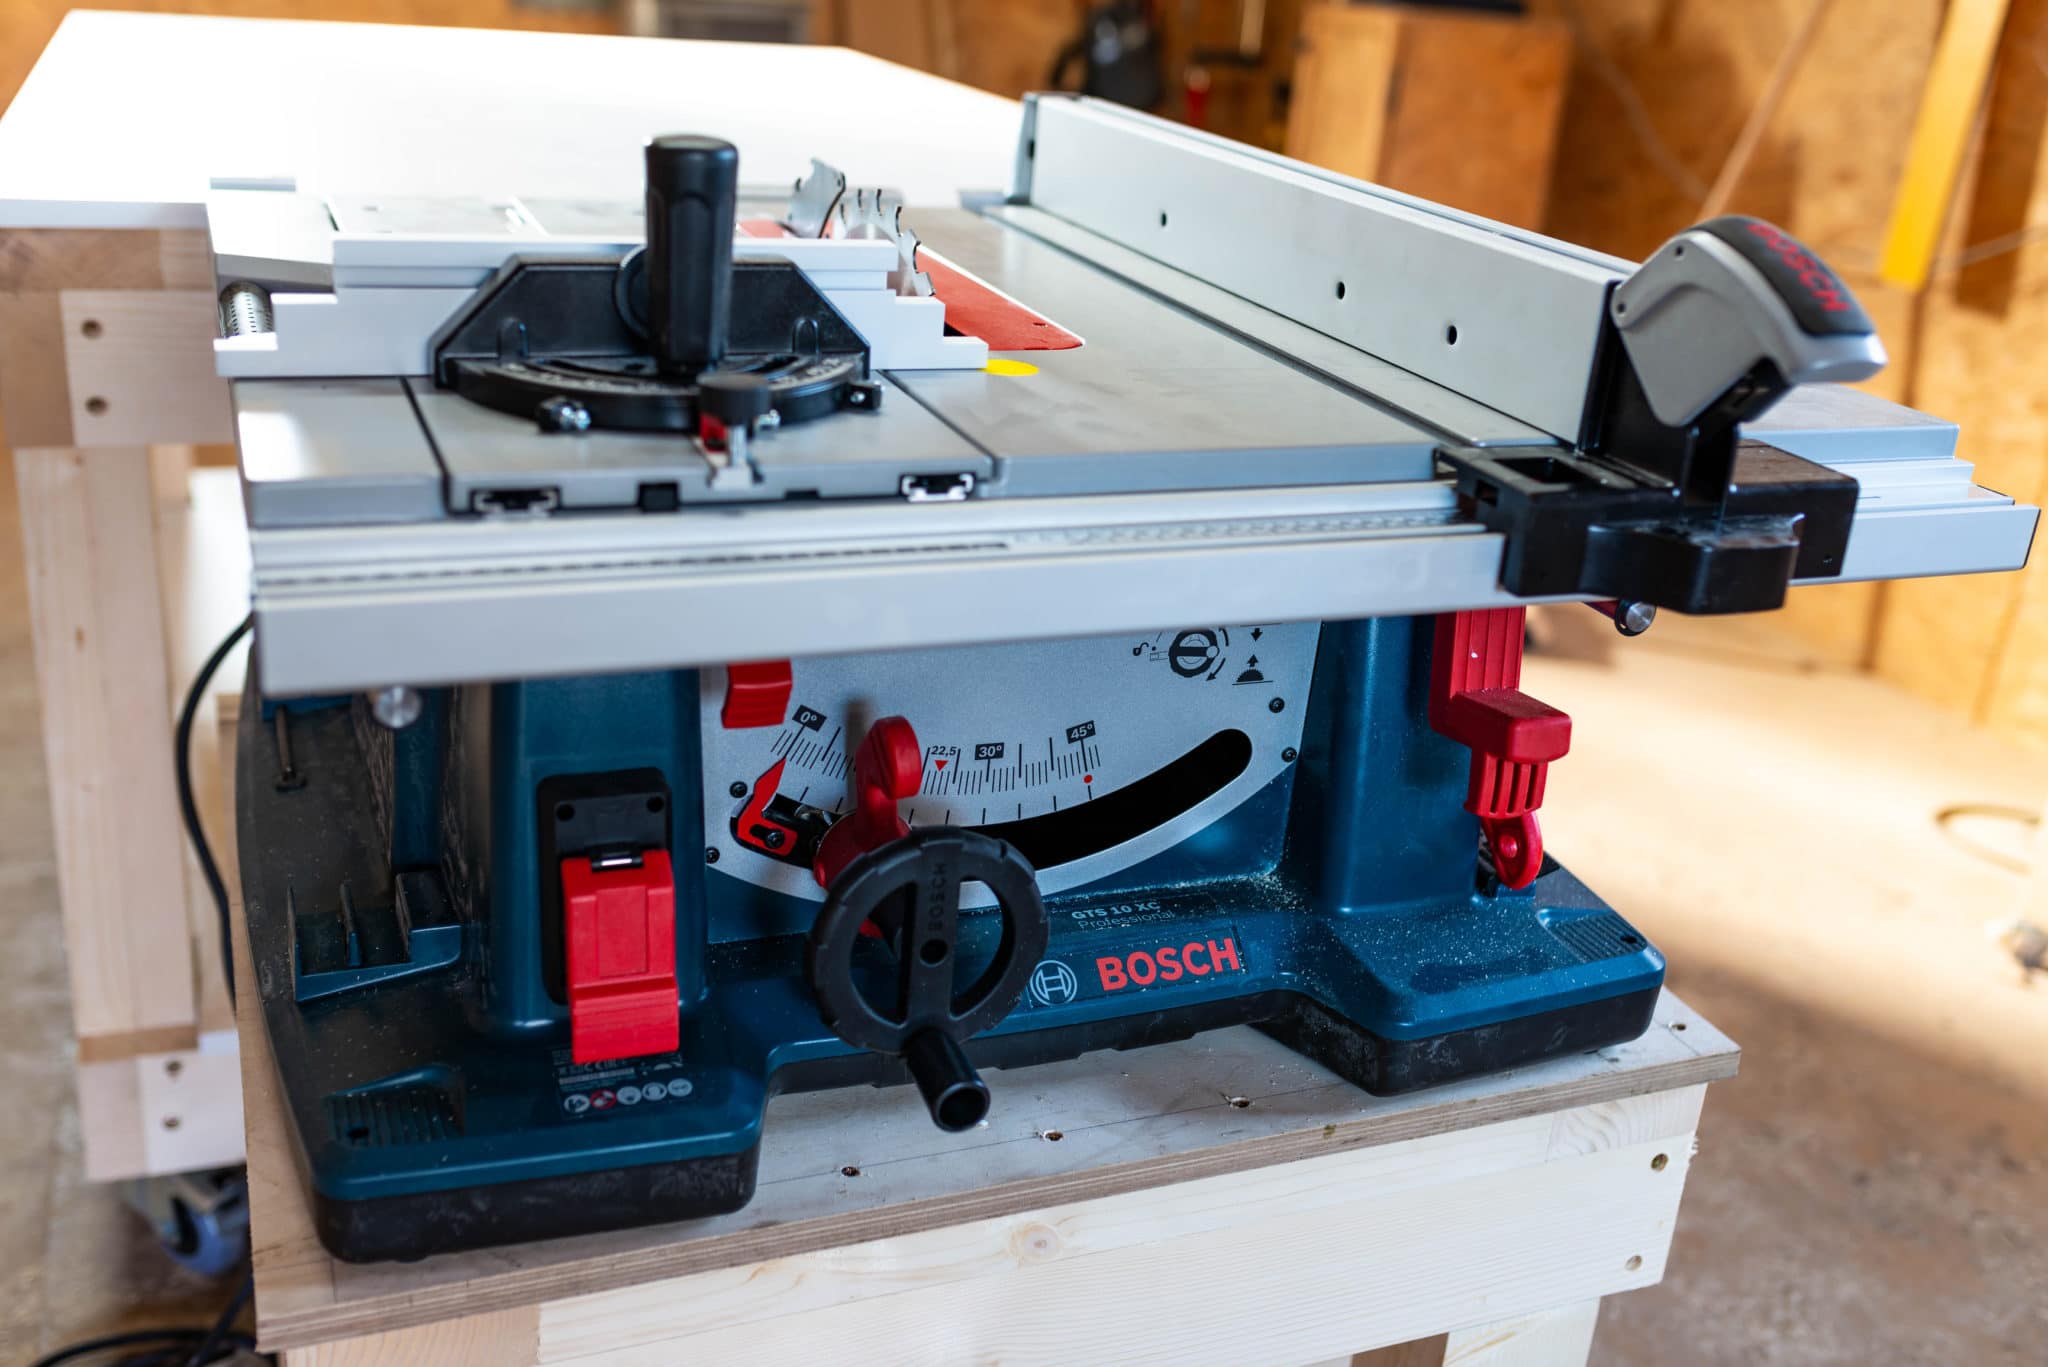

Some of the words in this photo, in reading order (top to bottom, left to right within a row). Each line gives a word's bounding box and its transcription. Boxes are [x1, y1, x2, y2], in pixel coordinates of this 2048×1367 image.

[1070, 722, 1094, 741] 45°
[930, 745, 957, 757] 22,5
[978, 744, 1002, 758] 30°
[1071, 908, 1108, 920] GTS
[1110, 904, 1132, 915] 10
[1134, 901, 1161, 912] XC
[1077, 910, 1177, 929] Professional
[1096, 937, 1241, 992] BOSCH
